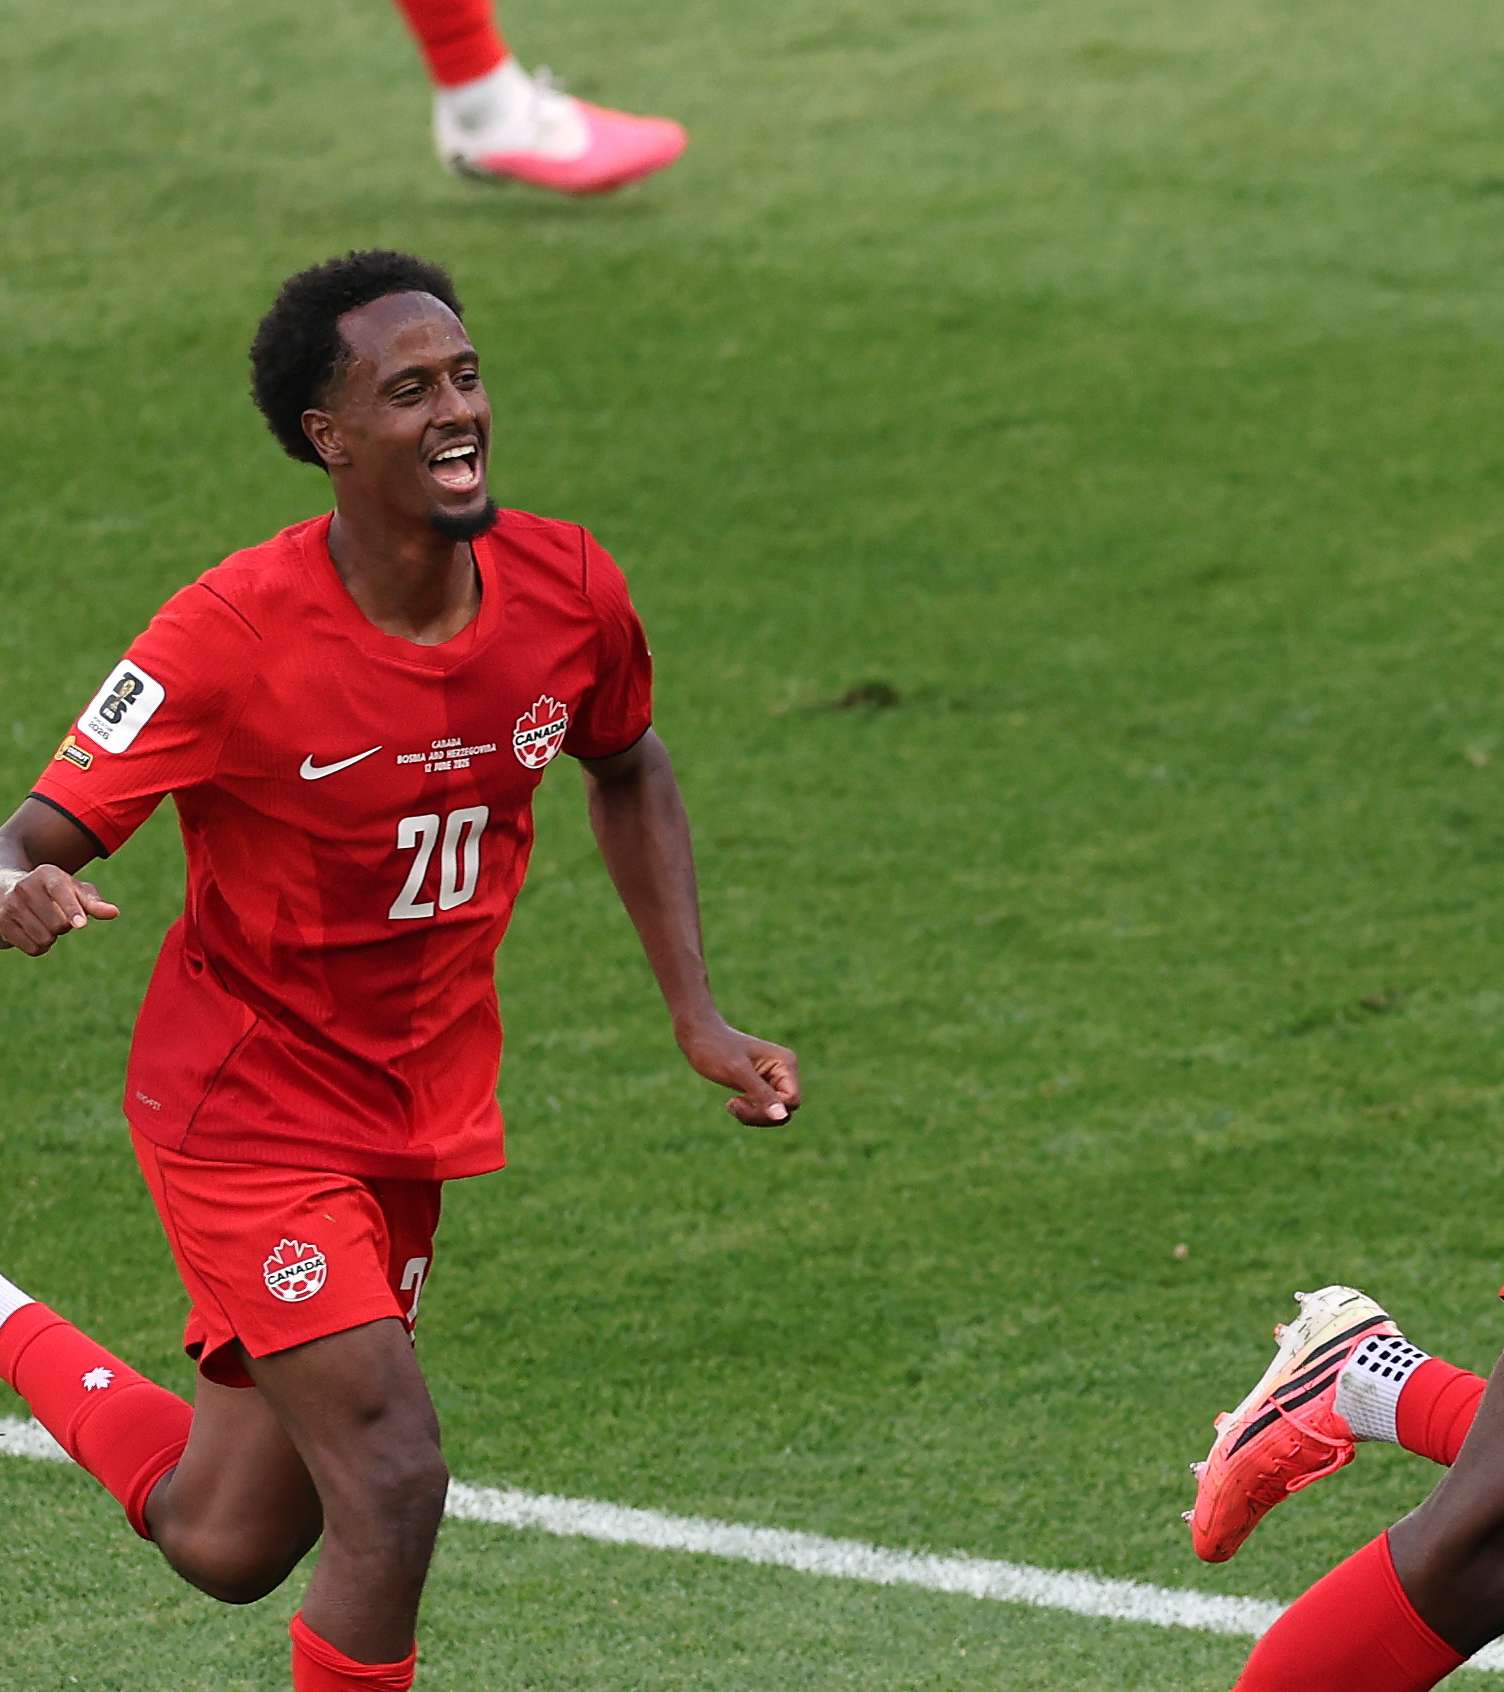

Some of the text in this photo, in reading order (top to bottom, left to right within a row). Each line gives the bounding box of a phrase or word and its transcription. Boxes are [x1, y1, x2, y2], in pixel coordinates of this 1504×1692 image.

[431, 738, 462, 749] CANADA
[516, 721, 564, 745] CANADA
[396, 742, 497, 765] BOSNIA AND HERZEGOVINA
[434, 760, 452, 771] JUNE
[388, 805, 489, 920] 20
[268, 1259, 324, 1285] CANADA
